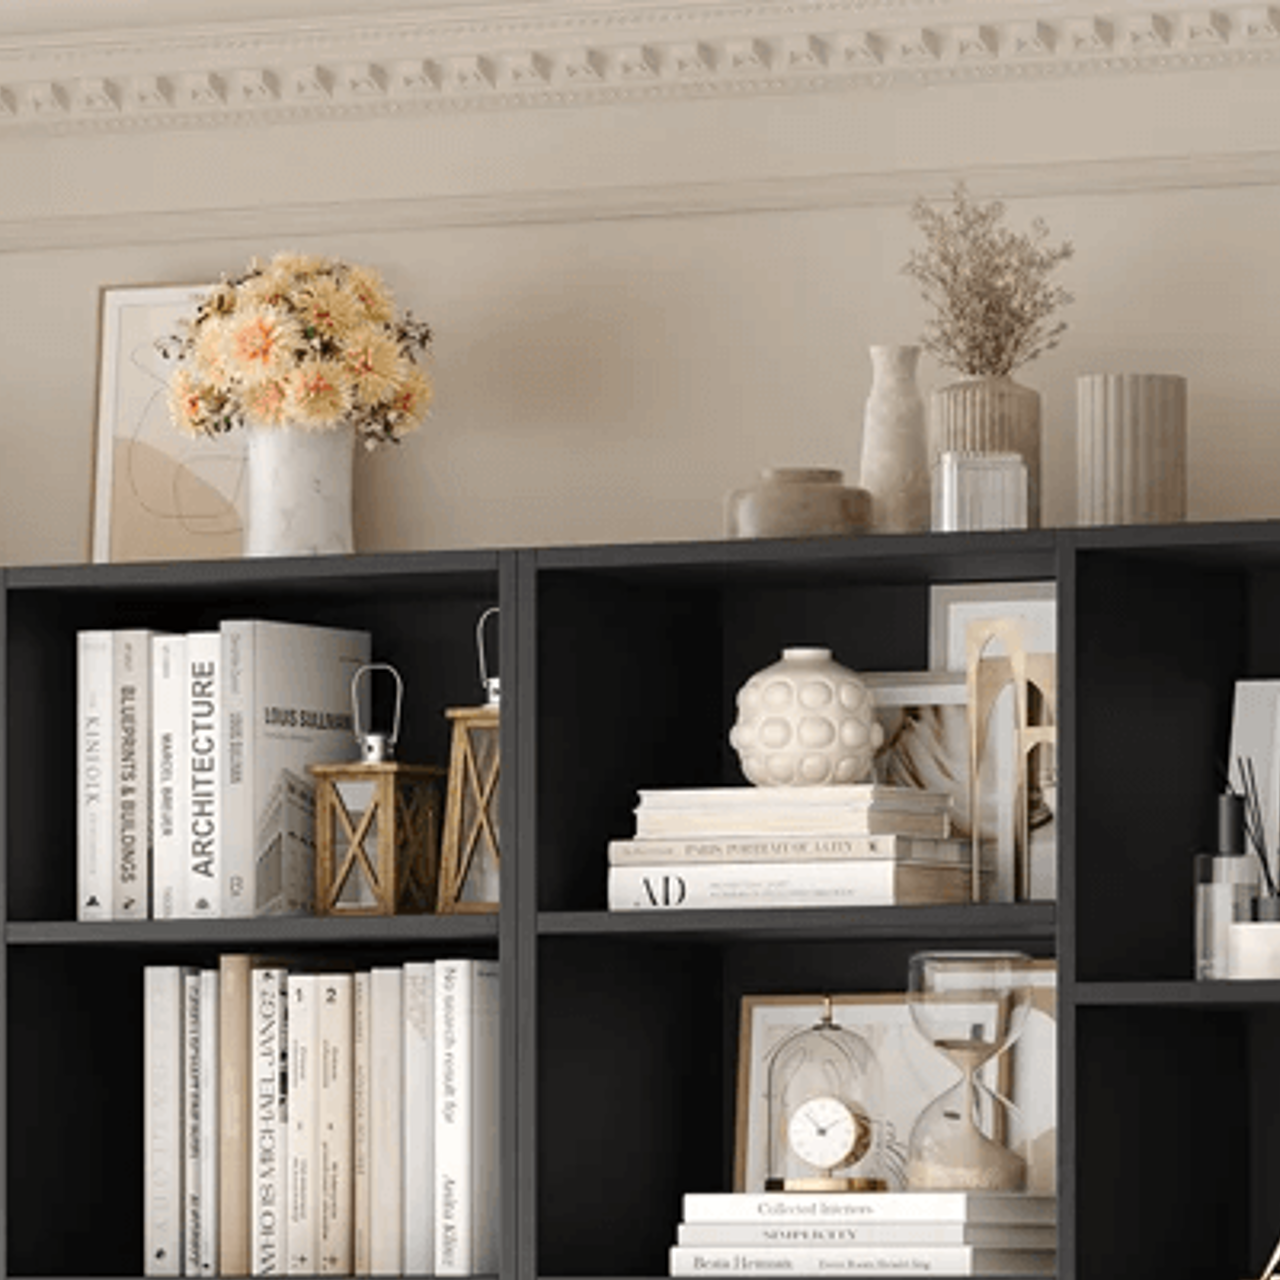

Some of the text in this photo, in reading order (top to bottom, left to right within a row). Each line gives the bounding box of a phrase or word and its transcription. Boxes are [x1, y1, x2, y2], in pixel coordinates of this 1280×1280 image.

[120, 685, 137, 782] BLUEPRINTS
[264, 706, 297, 727] LOUIS
[85, 715, 102, 807] KINFOLK
[120, 785, 137, 798] &
[191, 661, 215, 878] ARCHITECTURE
[120, 800, 137, 884] BUILDINGS
[634, 876, 686, 907] AD
[443, 967, 457, 1124] No search result for
[260, 1069, 276, 1179] MICHAEL
[260, 1185, 276, 1207] IS
[757, 1202, 817, 1216] Collected
[260, 1211, 276, 1275] WHO
